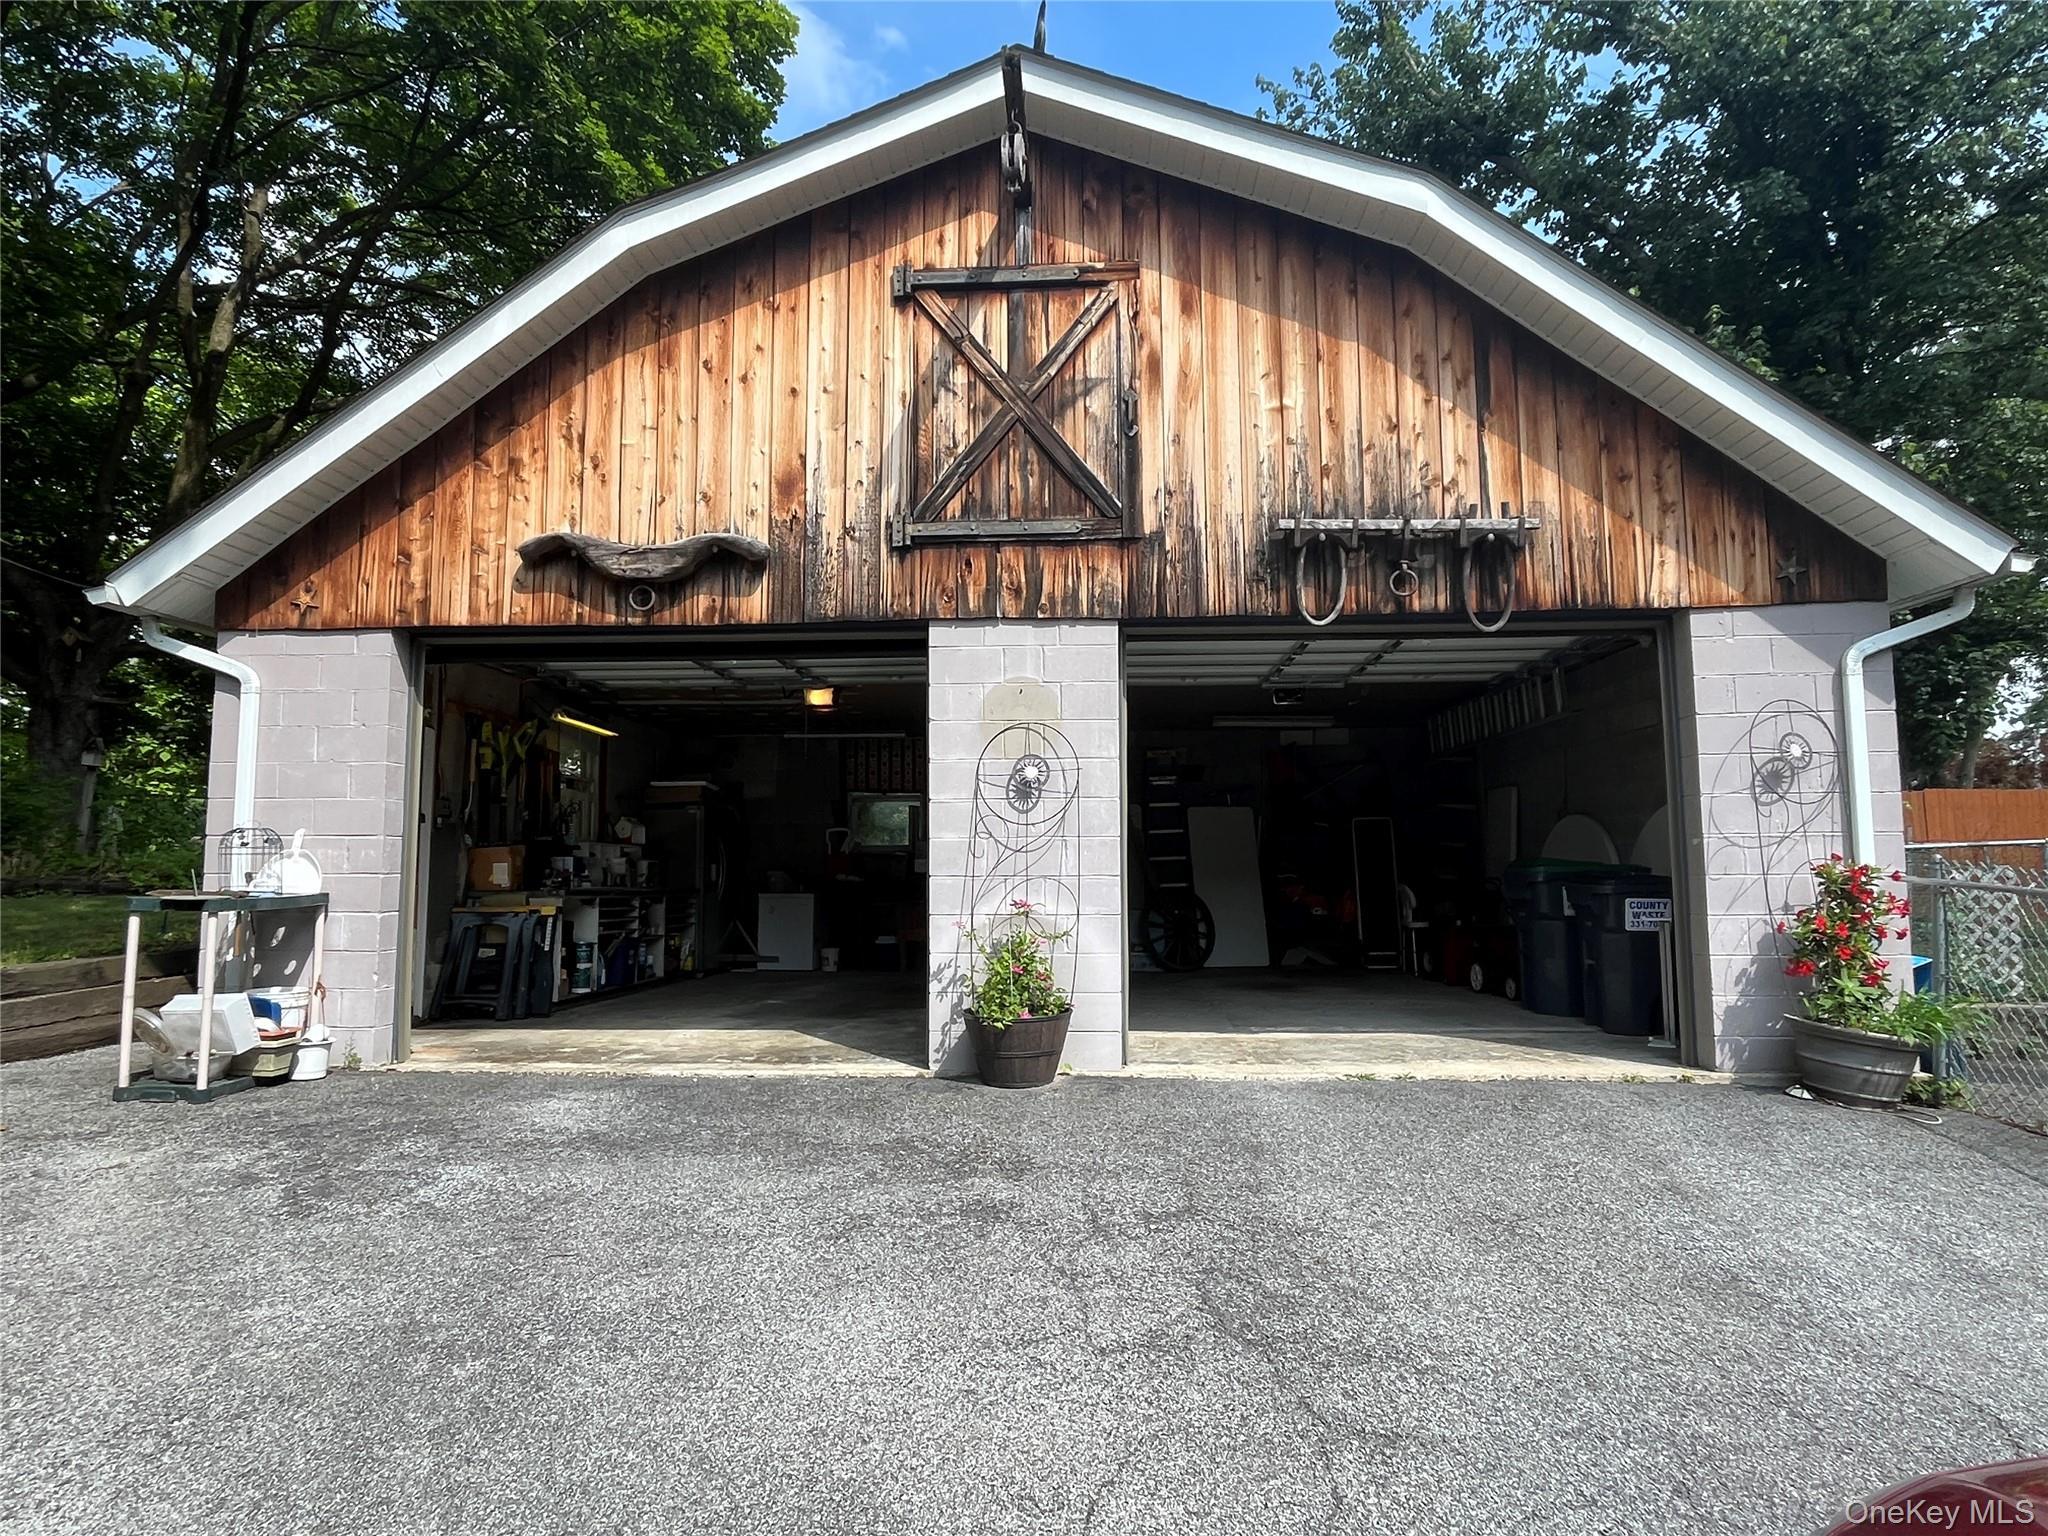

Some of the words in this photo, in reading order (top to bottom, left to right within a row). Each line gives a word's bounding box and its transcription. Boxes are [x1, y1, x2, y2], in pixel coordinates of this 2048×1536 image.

[1630, 901, 1668, 910] COUNTY
[1632, 911, 1665, 919] WASTE
[1630, 920, 1658, 928] 331-70
